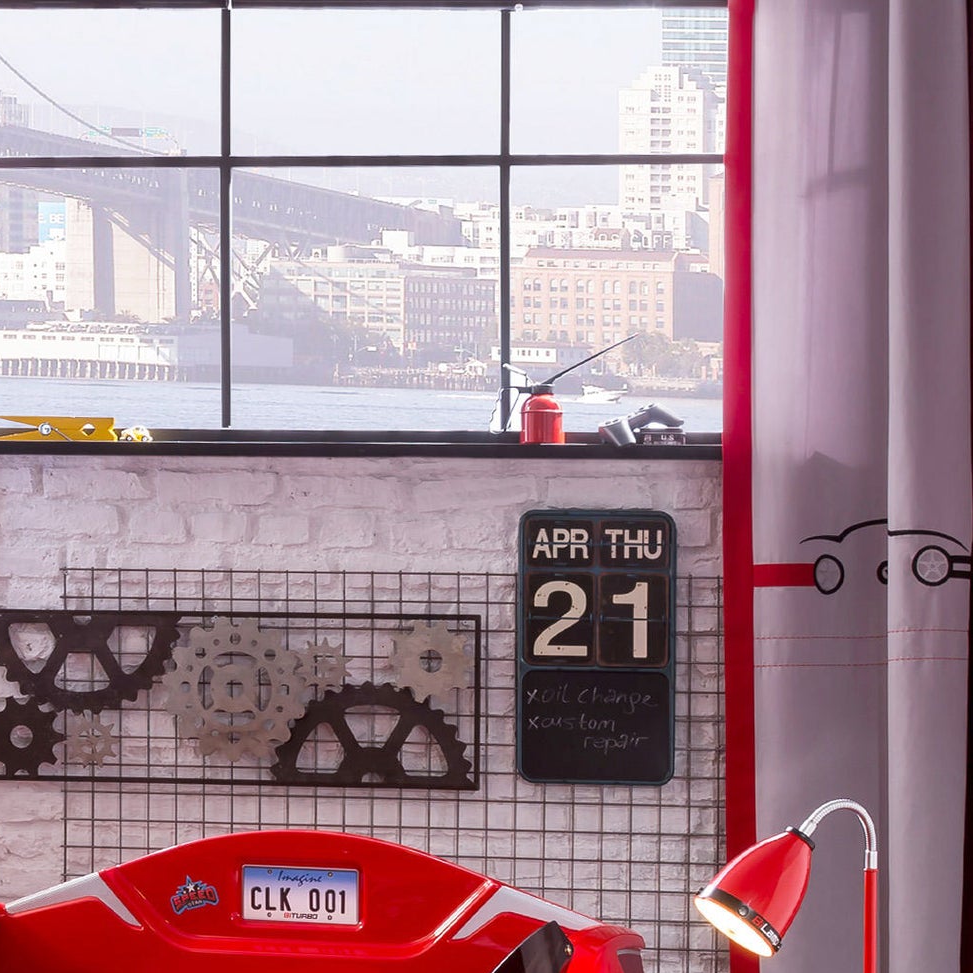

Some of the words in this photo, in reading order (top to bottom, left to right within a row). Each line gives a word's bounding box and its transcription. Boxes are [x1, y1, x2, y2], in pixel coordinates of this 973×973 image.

[531, 527, 589, 560] APR
[604, 528, 663, 560] THU
[277, 870, 323, 887] Imagine
[251, 886, 292, 912] CLK
[309, 887, 346, 914] 001
